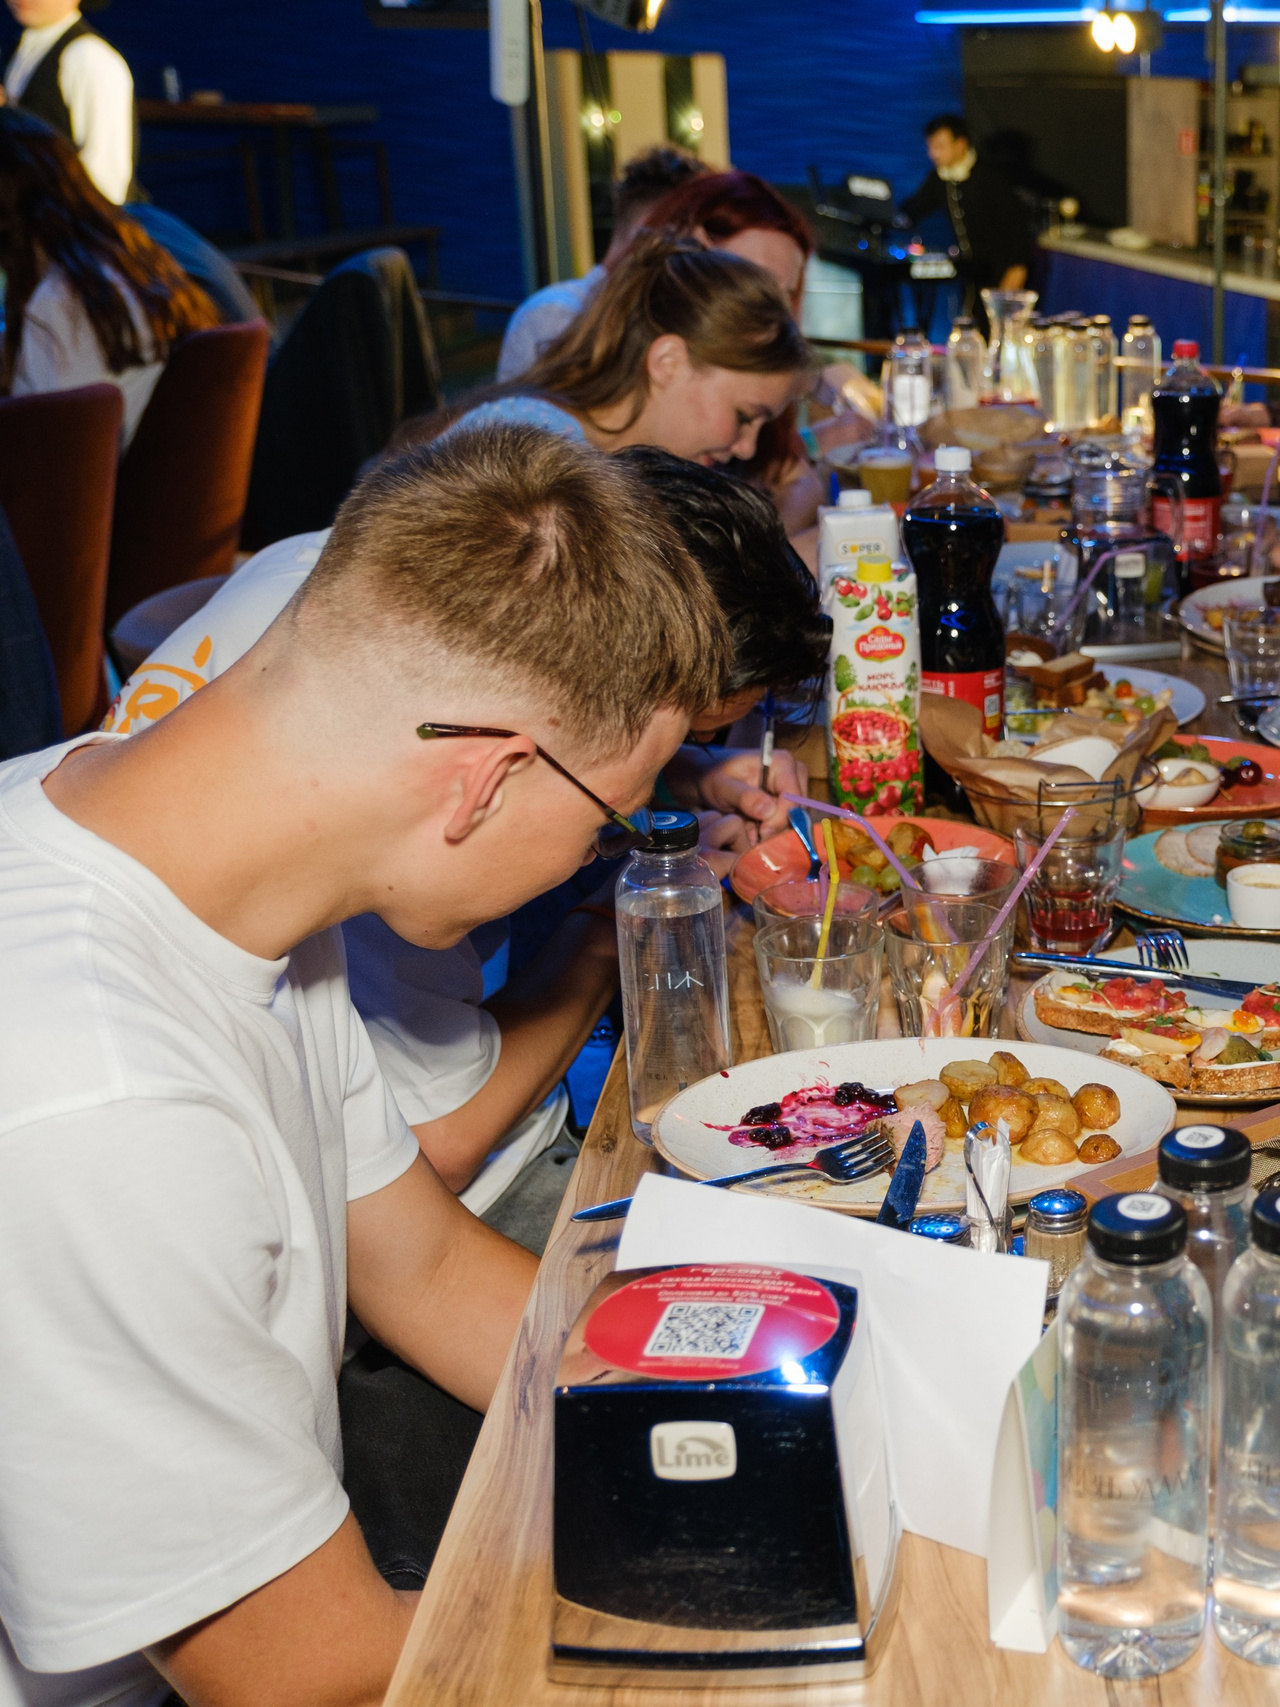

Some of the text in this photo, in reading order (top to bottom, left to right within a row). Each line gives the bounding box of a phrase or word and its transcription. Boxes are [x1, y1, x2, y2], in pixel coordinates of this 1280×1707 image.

[867, 672, 895, 682] МОРС
[732, 1289, 759, 1298] 50%
[656, 1436, 730, 1467] Lime
